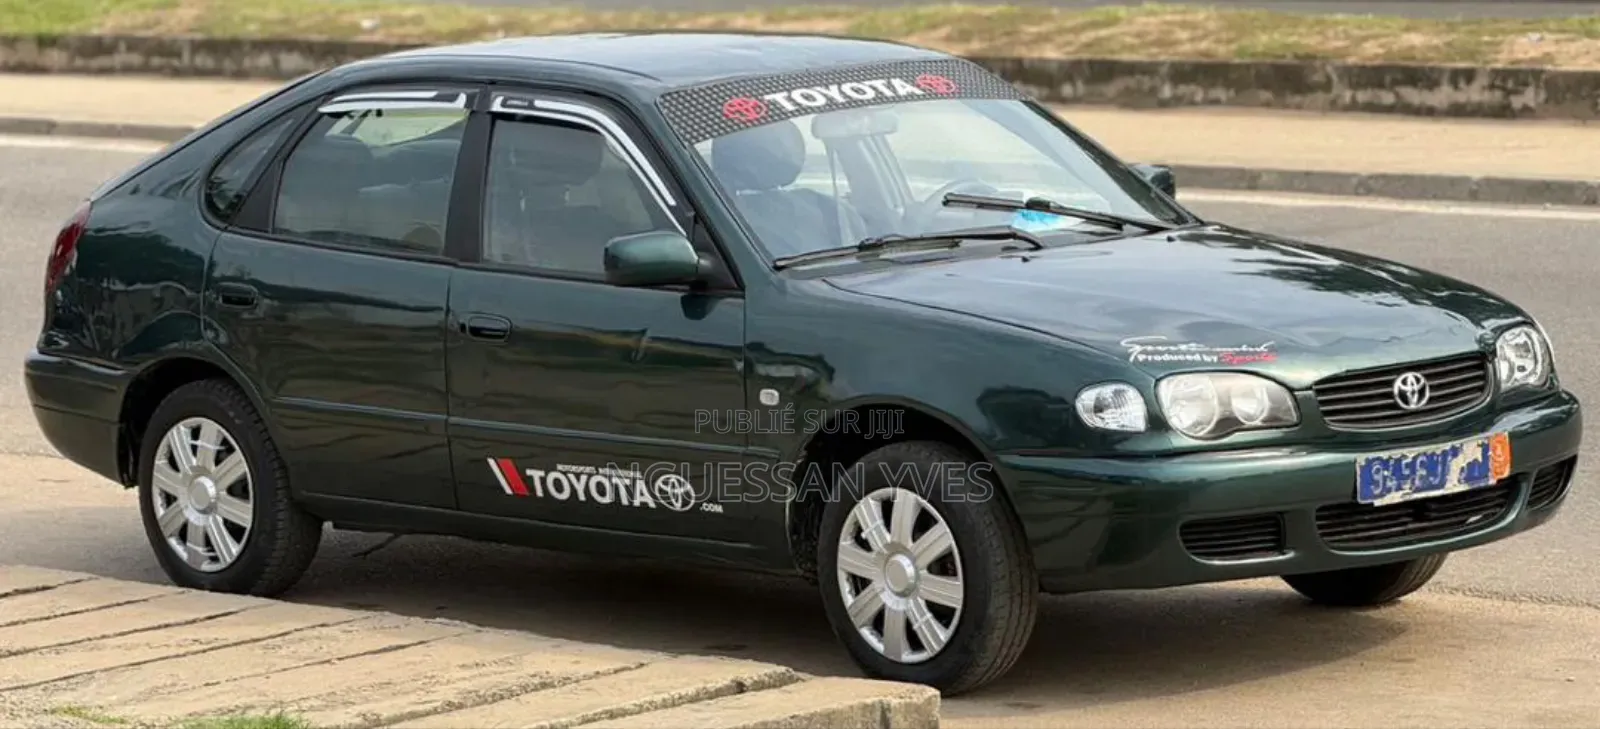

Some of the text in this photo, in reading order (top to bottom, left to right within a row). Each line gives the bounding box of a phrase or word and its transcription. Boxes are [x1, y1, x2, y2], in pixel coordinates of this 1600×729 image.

[763, 77, 923, 113] TOYOTA
[1137, 352, 1202, 363] Produced
[1203, 353, 1219, 363] by
[525, 468, 656, 509] TOYOTA
